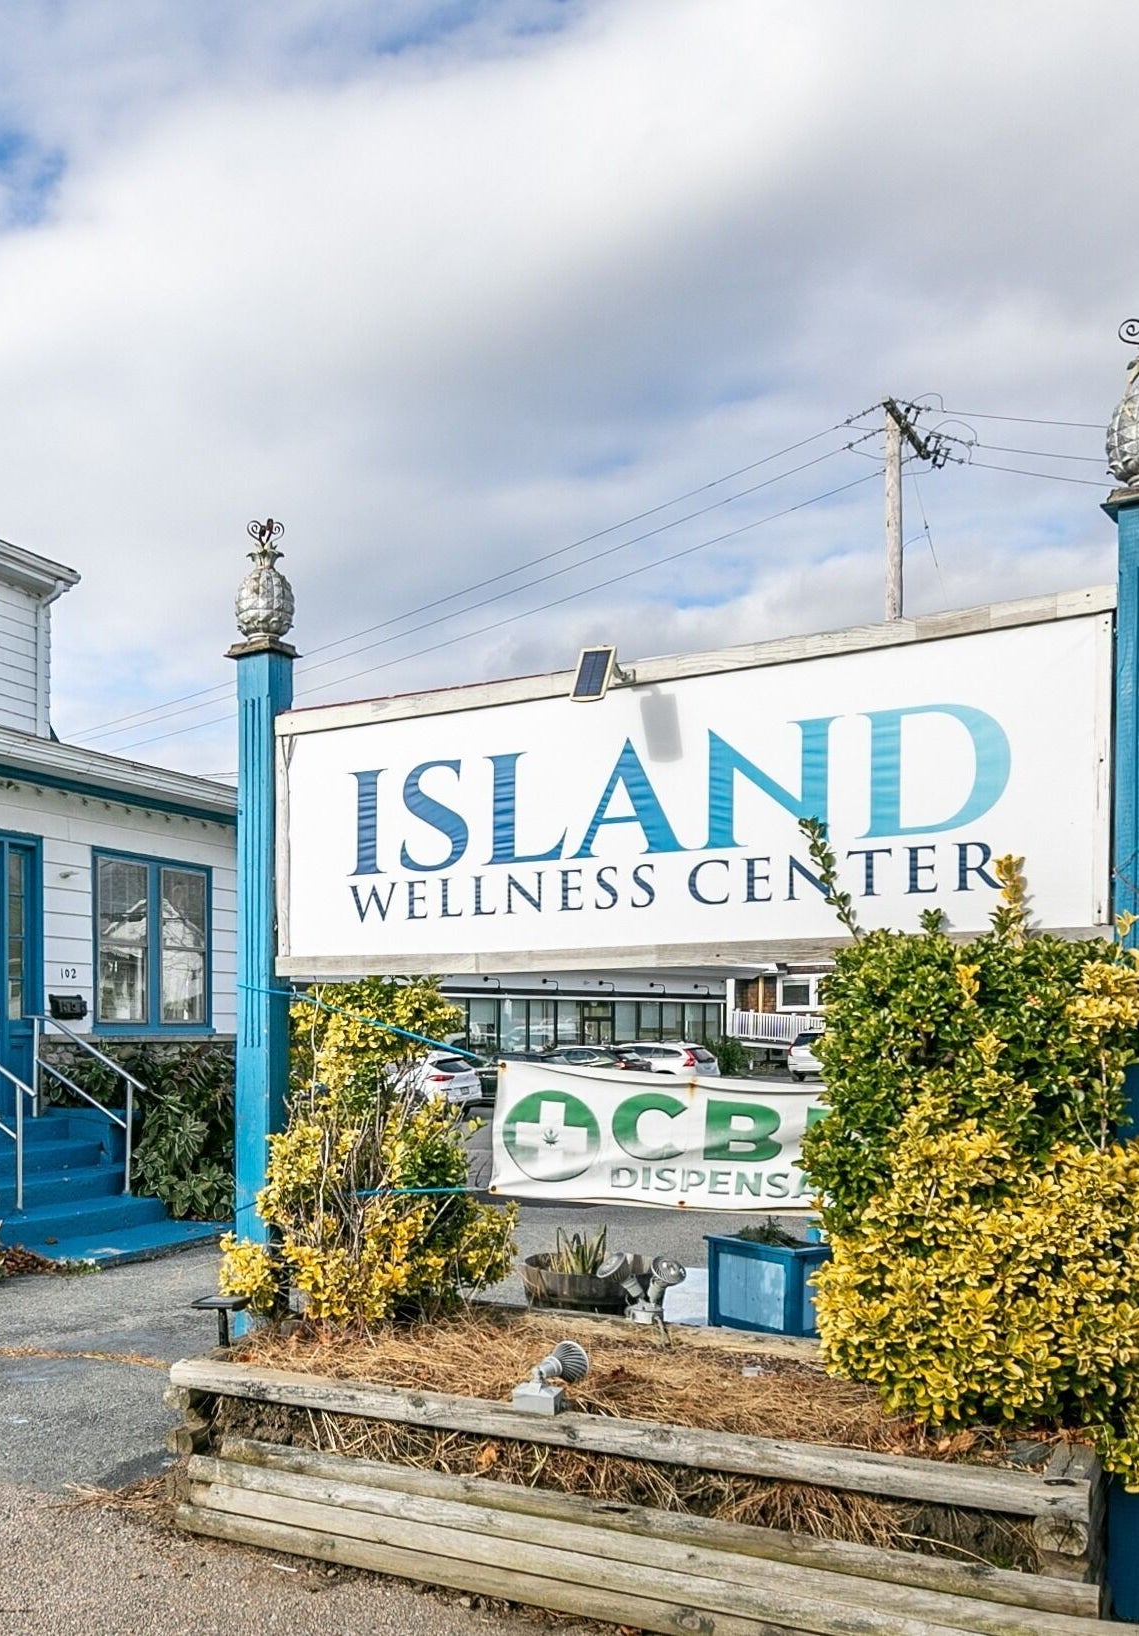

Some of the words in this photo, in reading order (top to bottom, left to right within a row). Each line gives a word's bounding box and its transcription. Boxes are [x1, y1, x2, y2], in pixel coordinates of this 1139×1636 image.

[346, 703, 1012, 876] ISLAND
[348, 864, 656, 923] WELLNESS
[60, 967, 77, 979] 102
[612, 1093, 832, 1162] CB
